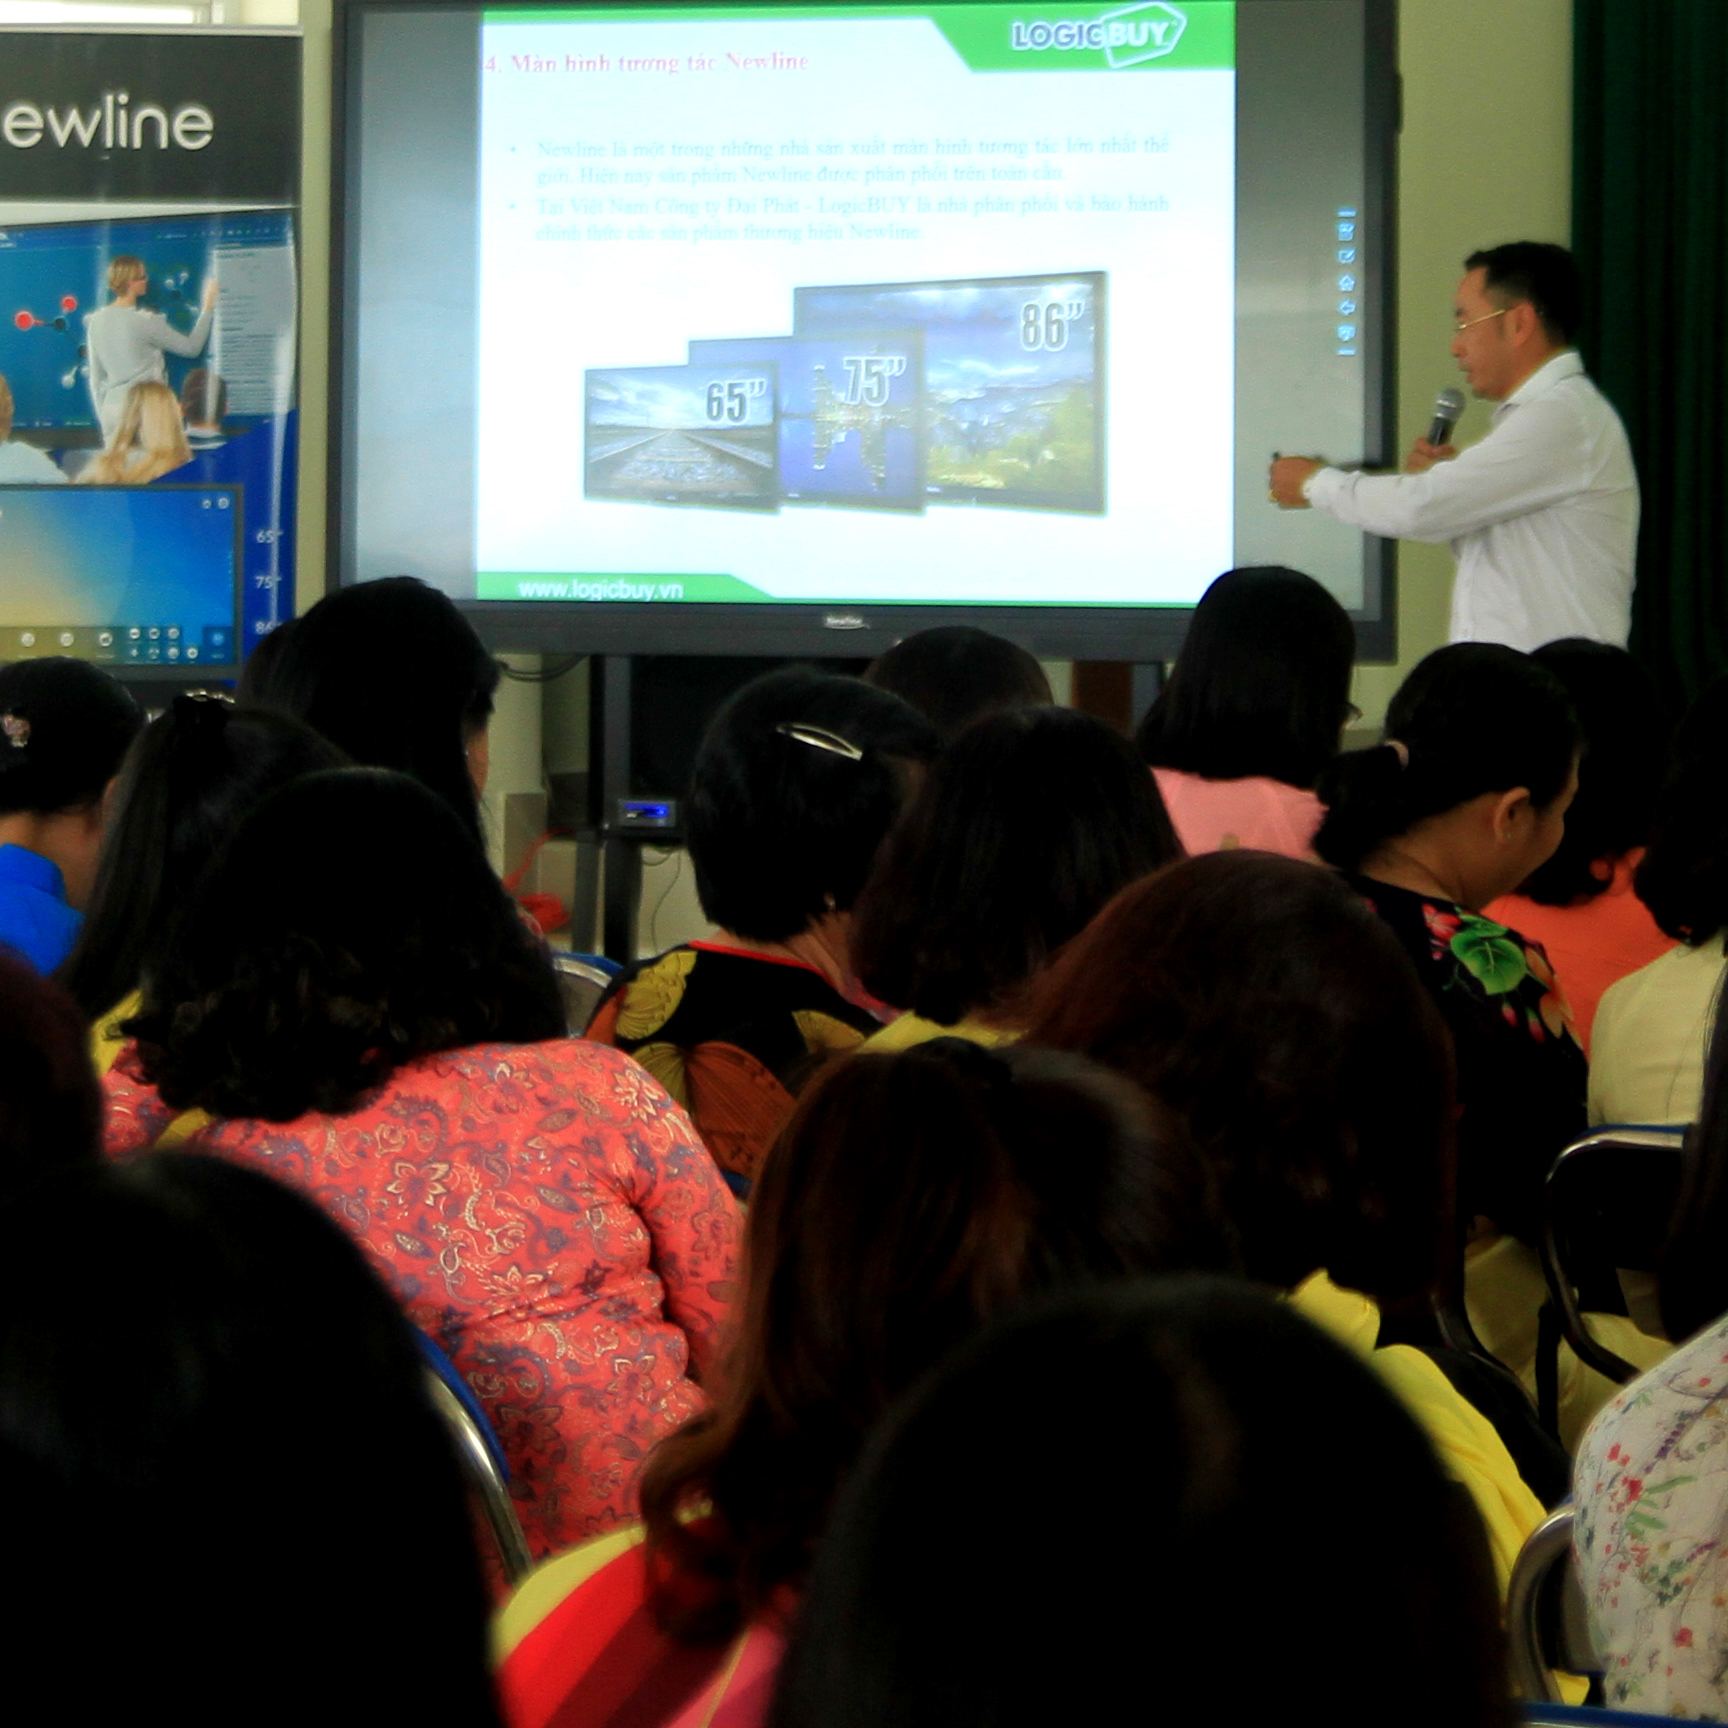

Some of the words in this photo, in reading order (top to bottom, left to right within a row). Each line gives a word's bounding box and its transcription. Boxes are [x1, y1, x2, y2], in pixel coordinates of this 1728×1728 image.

[511, 54, 556, 73] Màn
[565, 53, 610, 72] hình
[618, 55, 680, 76] tương
[687, 52, 716, 72] tác
[726, 50, 809, 71] Newline
[537, 140, 606, 158] Newline
[671, 142, 714, 162] trong
[742, 165, 811, 183] Newline
[610, 197, 649, 215] Nam
[817, 194, 911, 218] LogicBUY
[518, 578, 684, 602] www.logicbuy.vn
